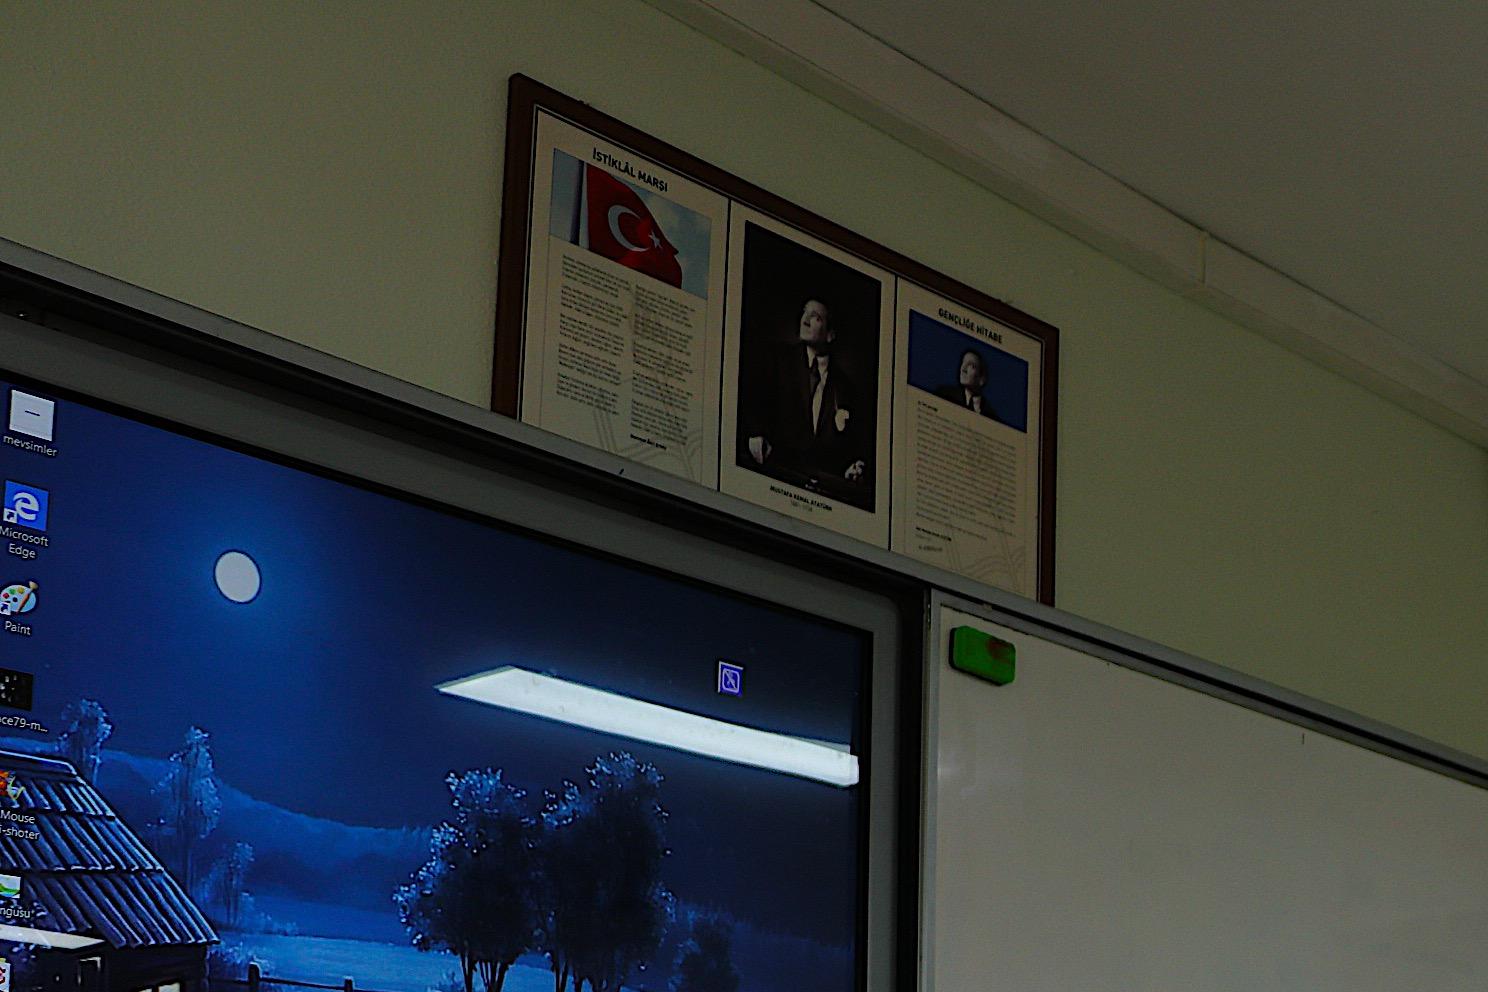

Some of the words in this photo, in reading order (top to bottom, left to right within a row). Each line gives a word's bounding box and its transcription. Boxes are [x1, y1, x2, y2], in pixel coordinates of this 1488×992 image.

[638, 170, 668, 192] MARŞI
[3, 434, 58, 457] mevsimler
[0, 525, 49, 548] Microsoft
[8, 542, 37, 560] Edge
[4, 620, 32, 637] Paint
[0, 809, 36, 825] Mouse
